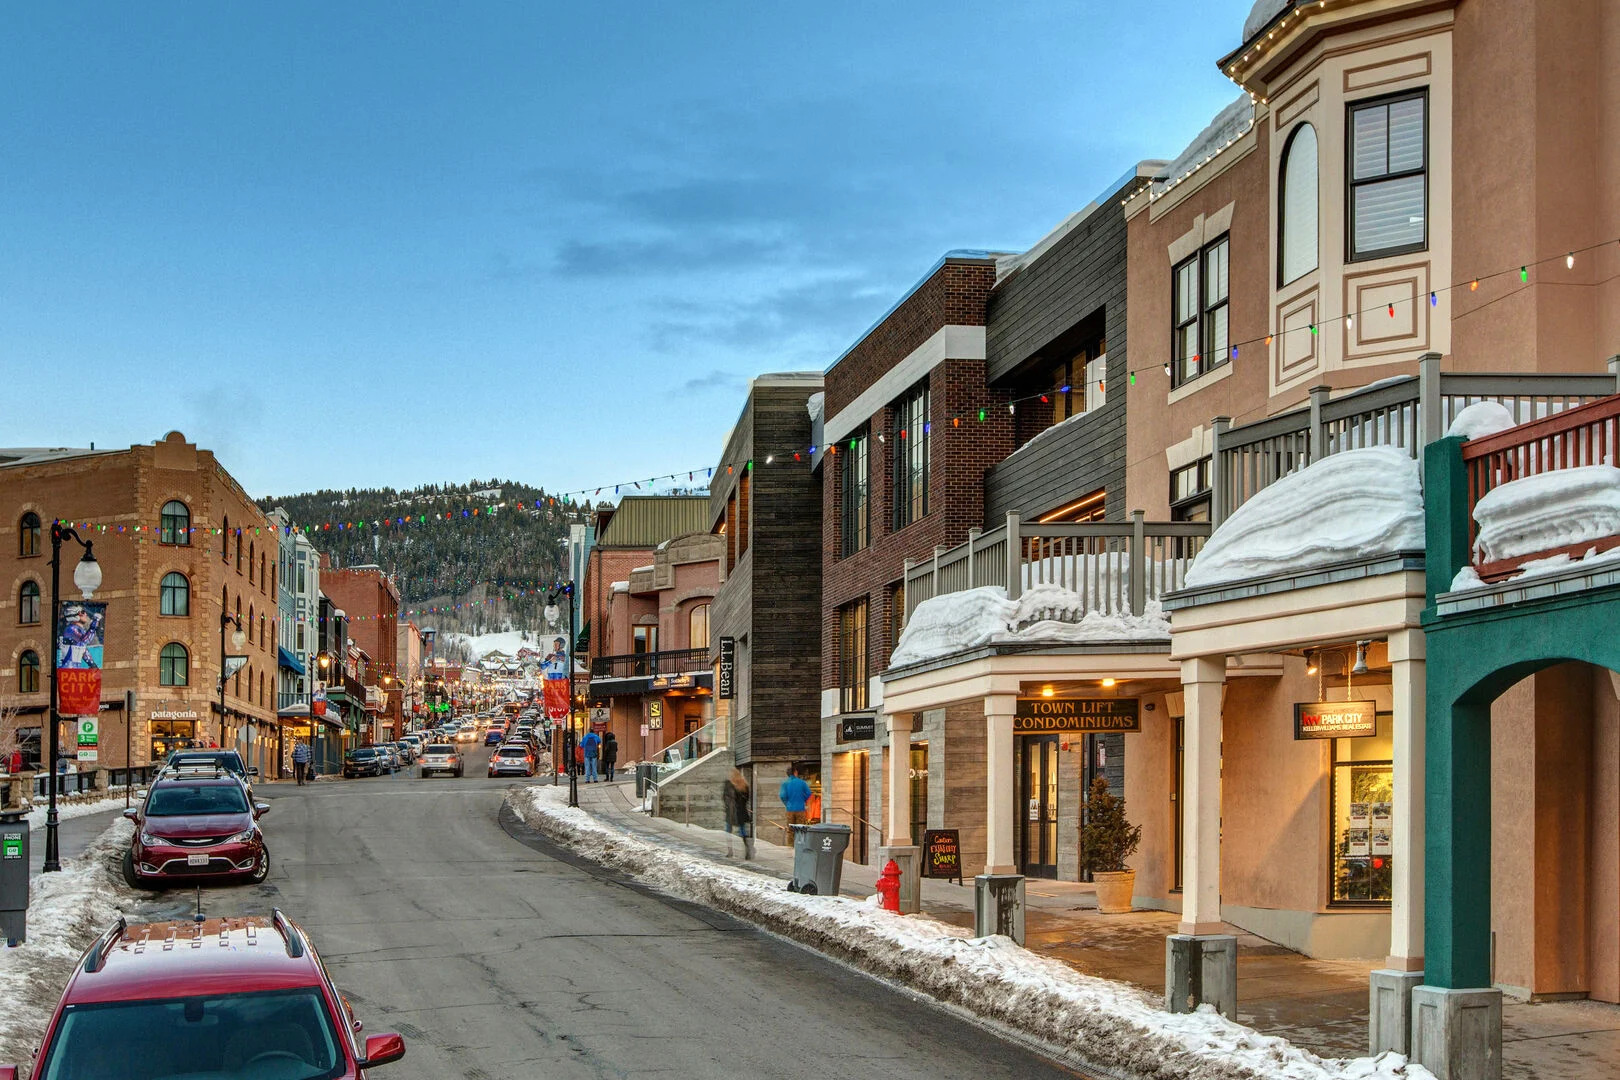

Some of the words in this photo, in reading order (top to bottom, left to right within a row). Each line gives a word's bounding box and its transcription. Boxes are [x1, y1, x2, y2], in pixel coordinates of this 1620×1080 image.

[61, 671, 97, 682] PARK
[61, 683, 97, 693] CITY
[1031, 702, 1075, 714] TOWN
[1082, 702, 1114, 714] LIFT
[151, 711, 197, 719] patagonia
[1321, 714, 1344, 725] PARK
[1344, 713, 1362, 724] CITY
[85, 724, 92, 732] P
[1014, 716, 1133, 729] CONDOMINIUMS
